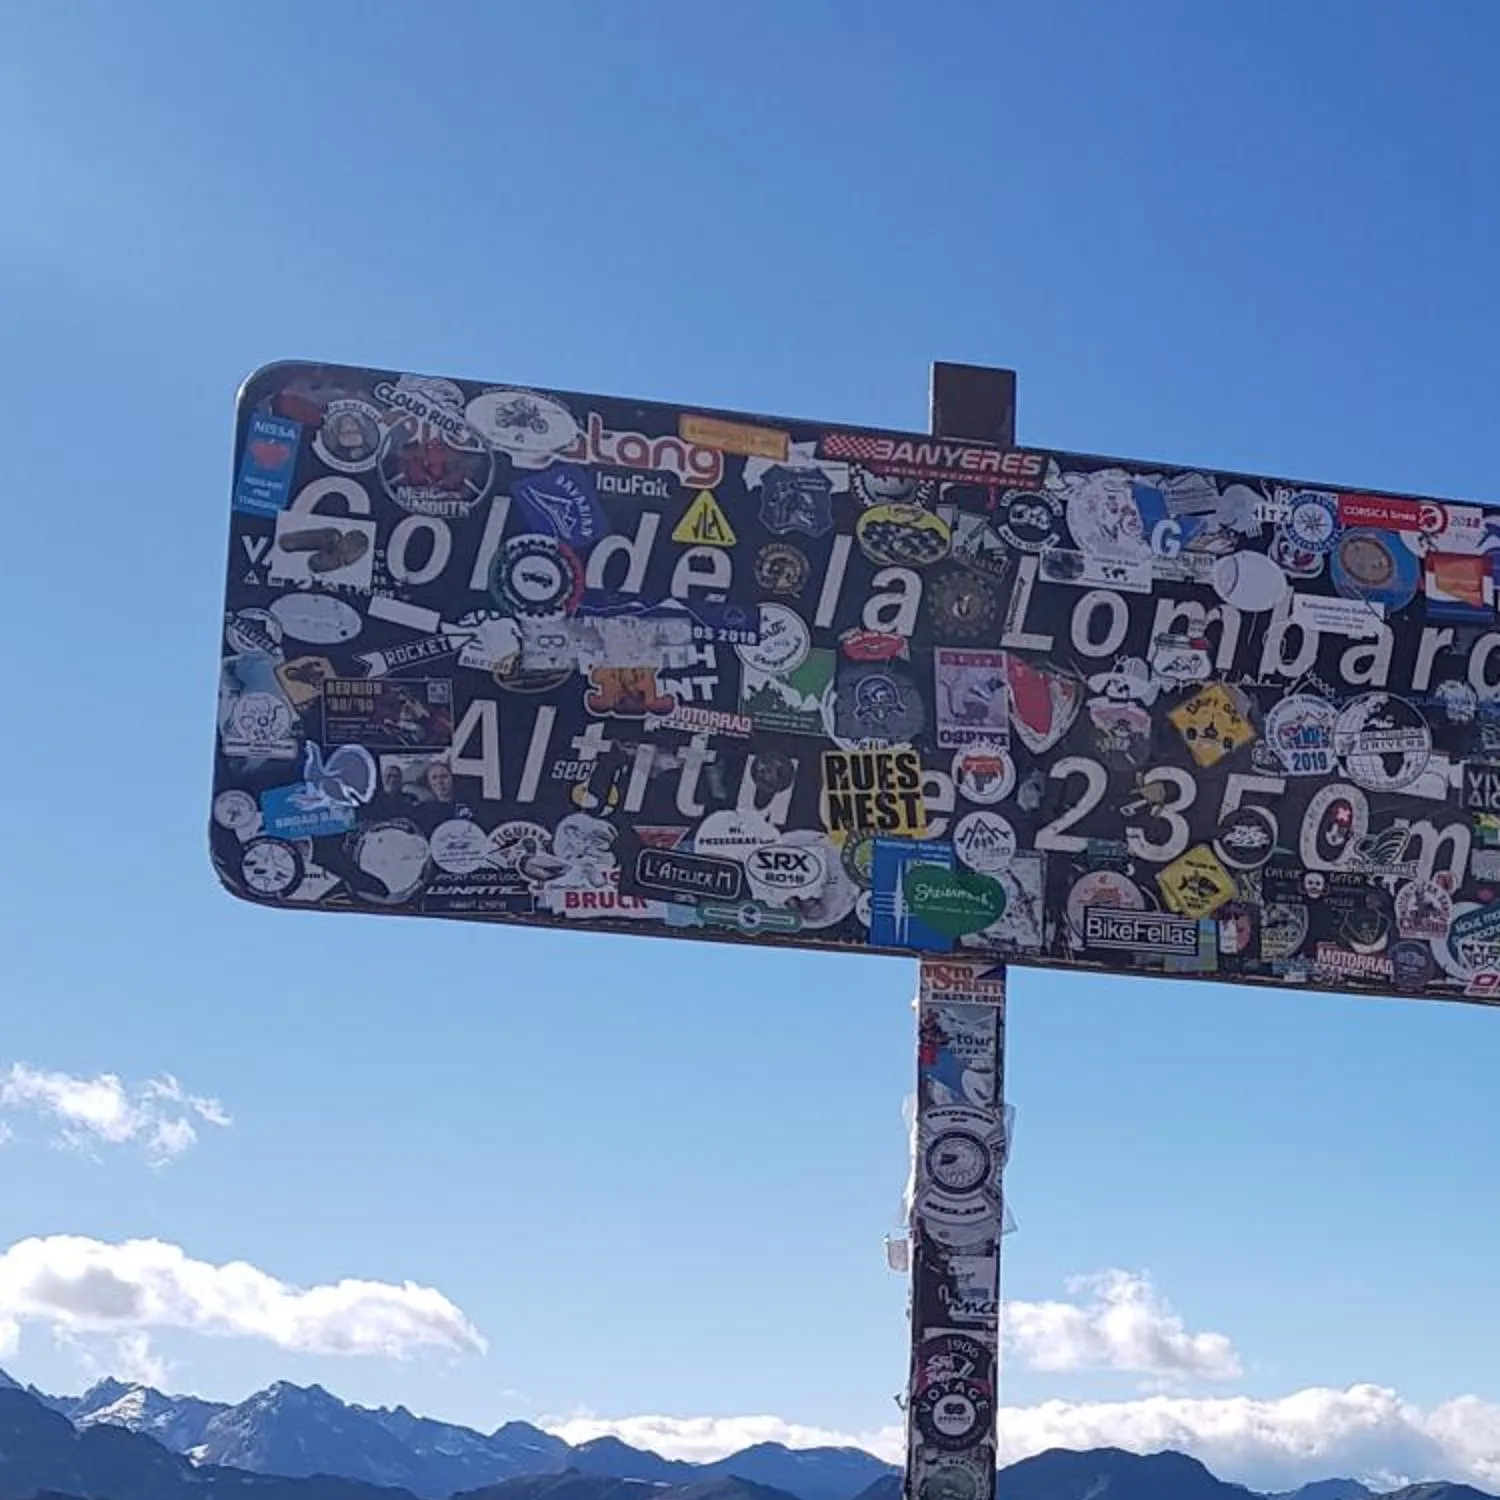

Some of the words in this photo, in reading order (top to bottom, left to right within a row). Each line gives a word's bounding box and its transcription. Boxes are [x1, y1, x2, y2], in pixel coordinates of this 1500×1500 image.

[376, 385, 428, 418] CLOUD
[429, 411, 467, 437] RIDE
[873, 438, 1043, 476] BANYERES
[587, 512, 734, 602] de
[815, 534, 923, 637] la
[386, 637, 449, 665] ROCKET
[825, 752, 919, 791] RUES
[1292, 751, 1328, 772] 2019
[450, 700, 956, 840] Altitue
[1034, 755, 1369, 873] 2350
[828, 792, 922, 831] NEST
[757, 851, 811, 873] SRX
[1087, 917, 1197, 946] BikeFellas
[1317, 951, 1395, 977] MOTORRAD
